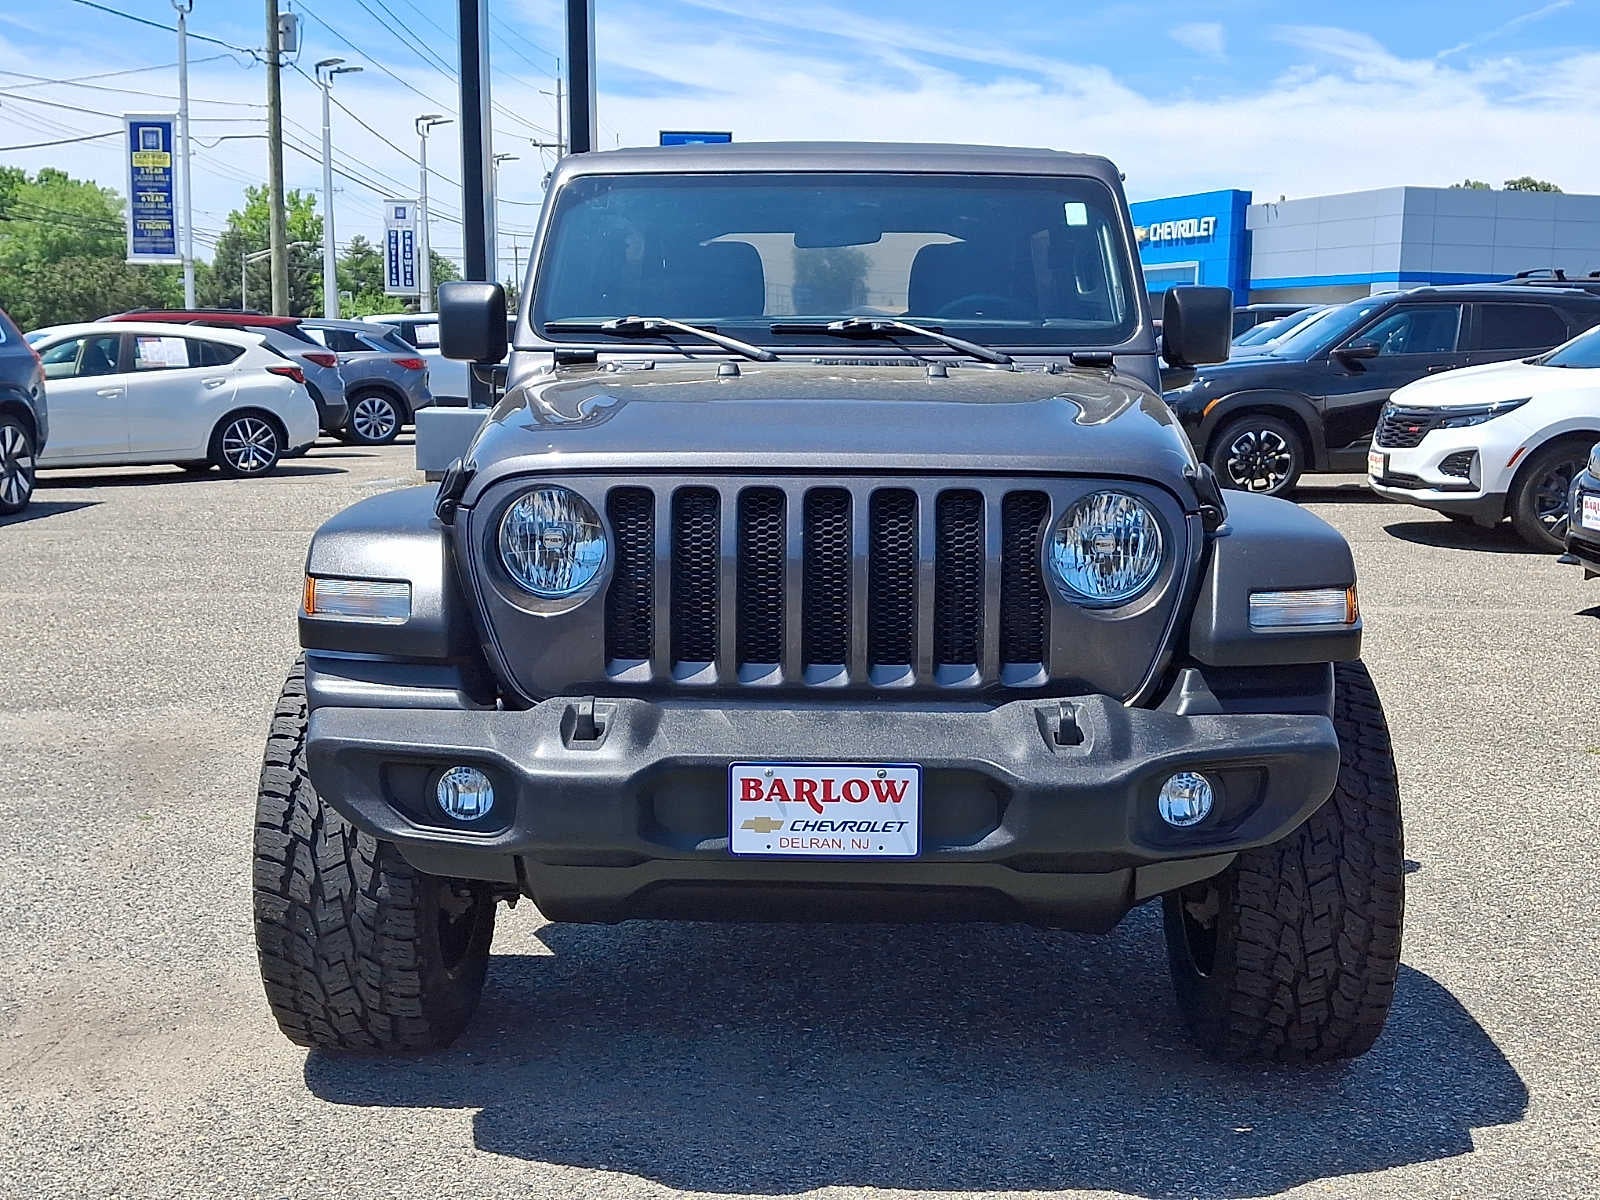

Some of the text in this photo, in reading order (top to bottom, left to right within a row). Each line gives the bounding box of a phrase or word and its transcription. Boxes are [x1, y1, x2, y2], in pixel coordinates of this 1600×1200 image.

[1149, 216, 1216, 241] CHEVROLET
[739, 778, 910, 815] BARLOW
[789, 819, 909, 833] CHEVROLET
[778, 837, 870, 851] DELRAN, NJ
